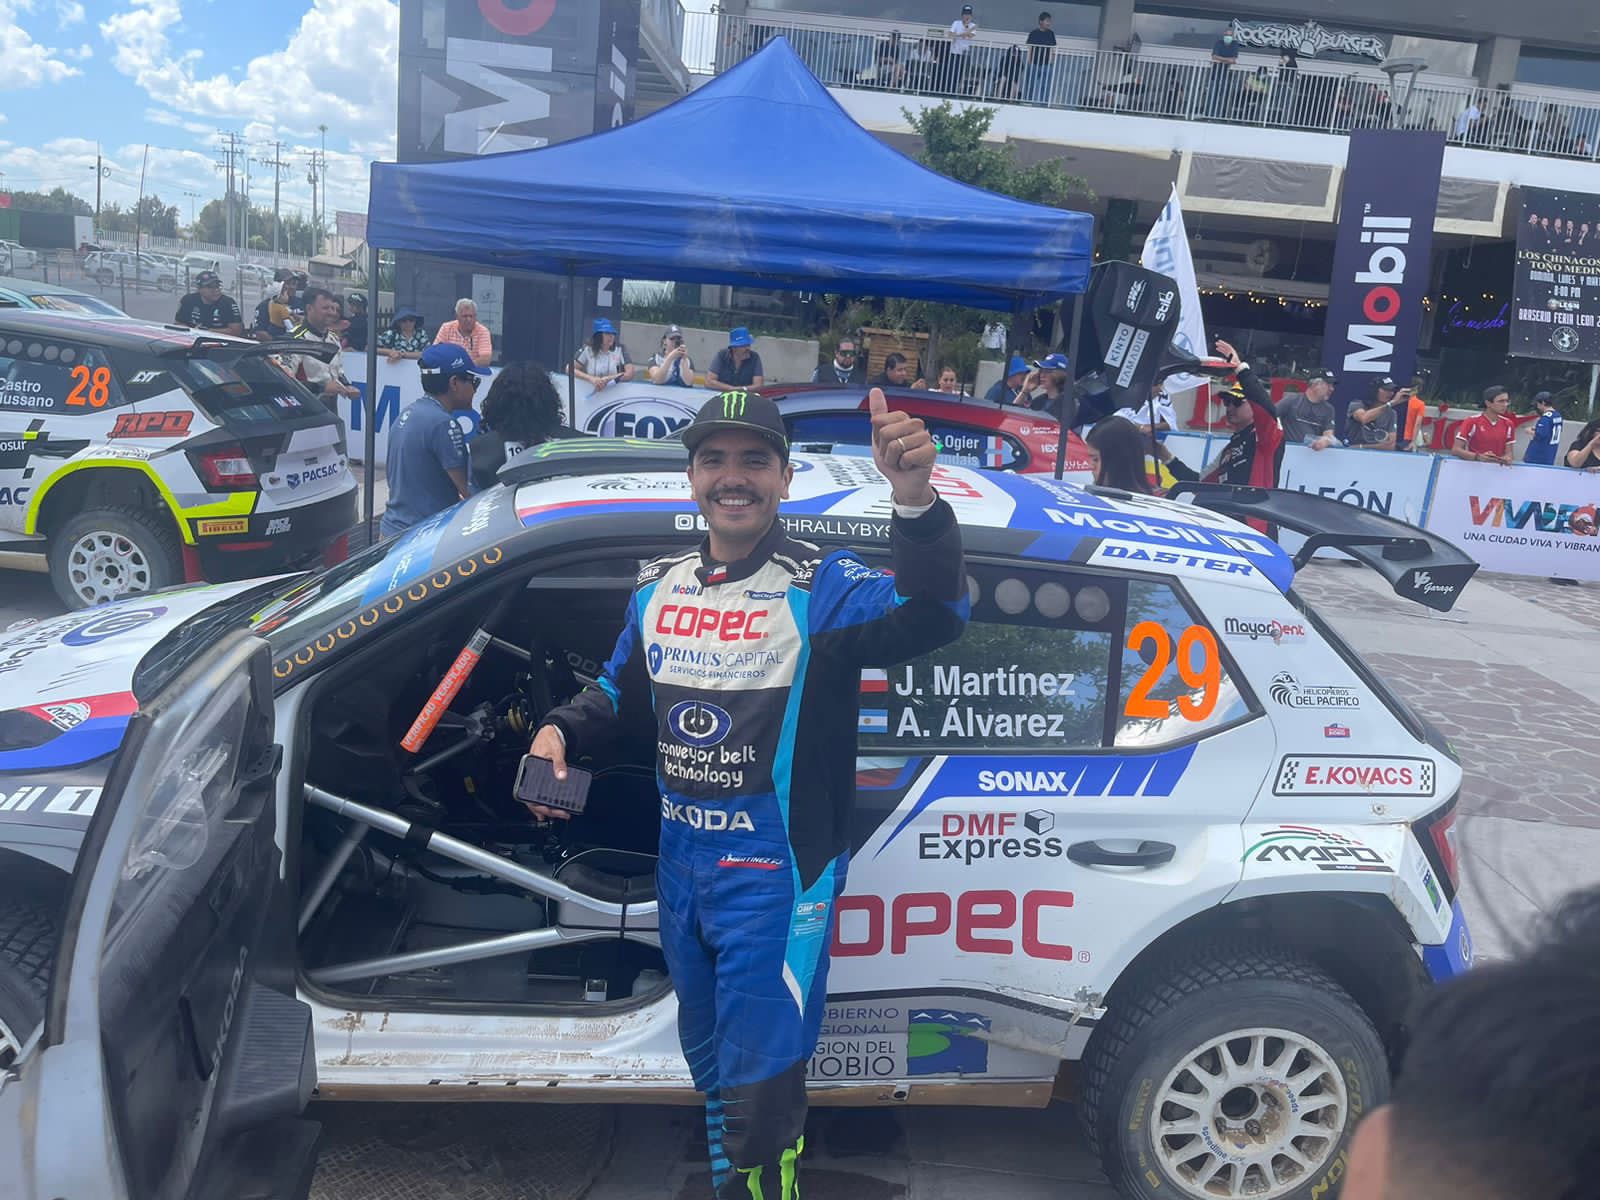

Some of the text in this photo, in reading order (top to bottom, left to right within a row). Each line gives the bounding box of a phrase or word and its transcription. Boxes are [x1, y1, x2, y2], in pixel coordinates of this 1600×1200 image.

[1232, 19, 1385, 60] ROCKSTAR BURGER
[1518, 251, 1541, 260] LOS
[1343, 216, 1411, 373] Mobil
[1111, 327, 1129, 362] KINTO
[65, 365, 111, 407] 28
[614, 412, 692, 440] FOX
[945, 434, 980, 452] Ogier
[302, 463, 338, 483] PACSAC
[1043, 507, 1212, 546] Mobil
[1463, 531, 1486, 542] UNA
[1488, 534, 1527, 545] CIUDAD
[1530, 538, 1552, 548] VIVA
[1555, 540, 1563, 549] Y
[1102, 545, 1253, 576] DASTER
[637, 567, 660, 582] OMP
[671, 583, 697, 596] Mobil
[1424, 582, 1454, 595] Garage
[663, 646, 784, 668] PRIMUS CAPITAL
[669, 665, 708, 678] SERVICIOS
[895, 663, 1076, 697] J. Martínez
[1124, 621, 1222, 723] 29
[1295, 695, 1315, 706] DEL
[896, 698, 1065, 738] A. Álvarez
[657, 741, 756, 769] conveyor belt
[664, 756, 744, 789] technology
[978, 769, 1069, 793] SONAX
[661, 794, 756, 832] ŠKODA
[942, 812, 1017, 837] DMF
[919, 832, 1063, 865] Express
[829, 889, 1074, 962] OPEC
[823, 1007, 899, 1019] BIERNO
[820, 1024, 889, 1035] GIONAL
[814, 1040, 896, 1055] GION DEL
[809, 1055, 895, 1078] IOBIO
